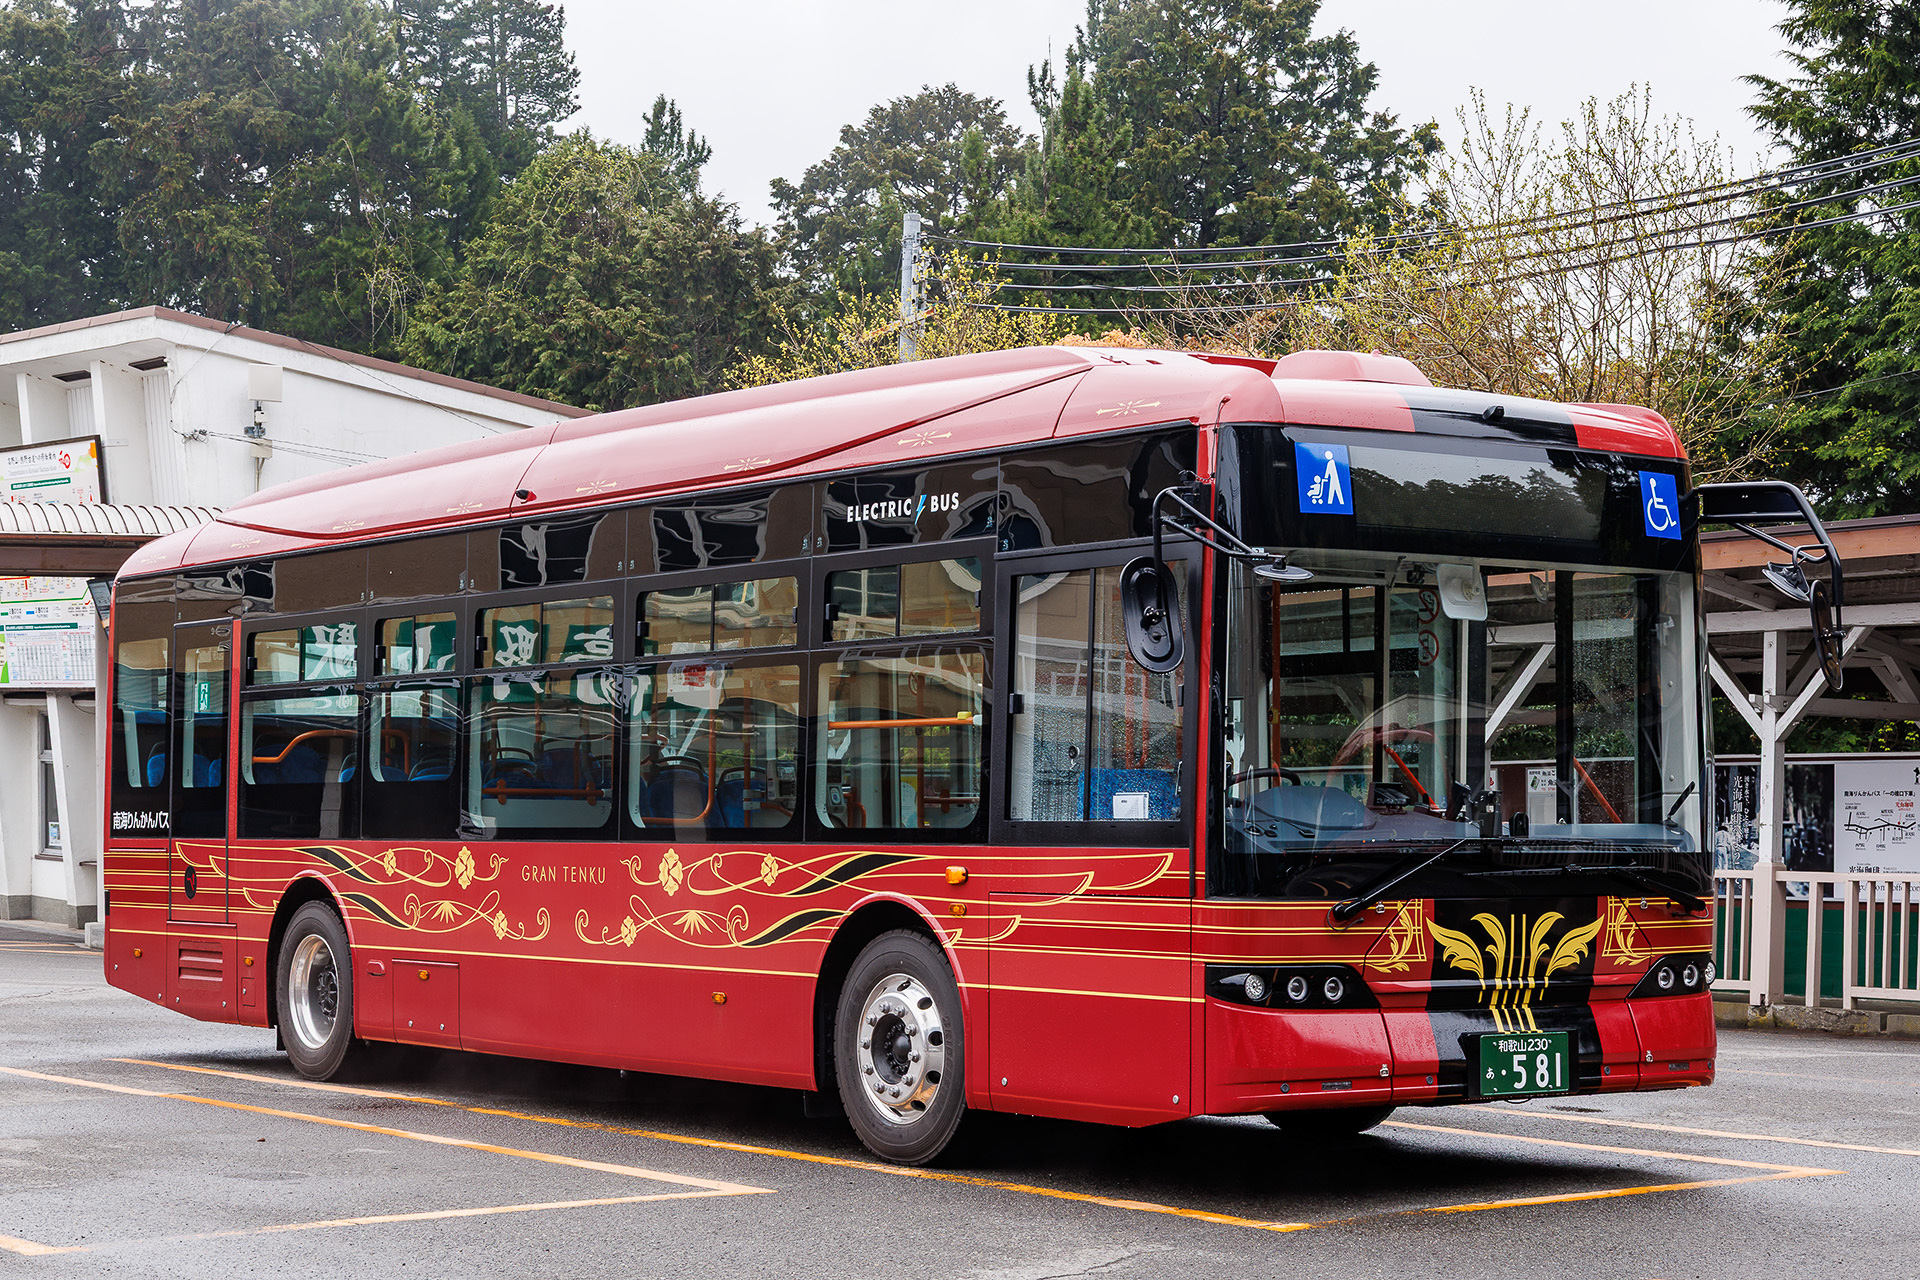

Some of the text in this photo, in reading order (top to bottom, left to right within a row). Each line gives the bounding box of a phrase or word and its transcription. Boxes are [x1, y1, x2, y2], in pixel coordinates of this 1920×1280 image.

[846, 491, 960, 522] ELECTRIC BUS
[113, 811, 169, 829] 南海りんかんバス
[521, 864, 606, 884] GRAN TENKU
[1485, 1067, 1495, 1080] あ
